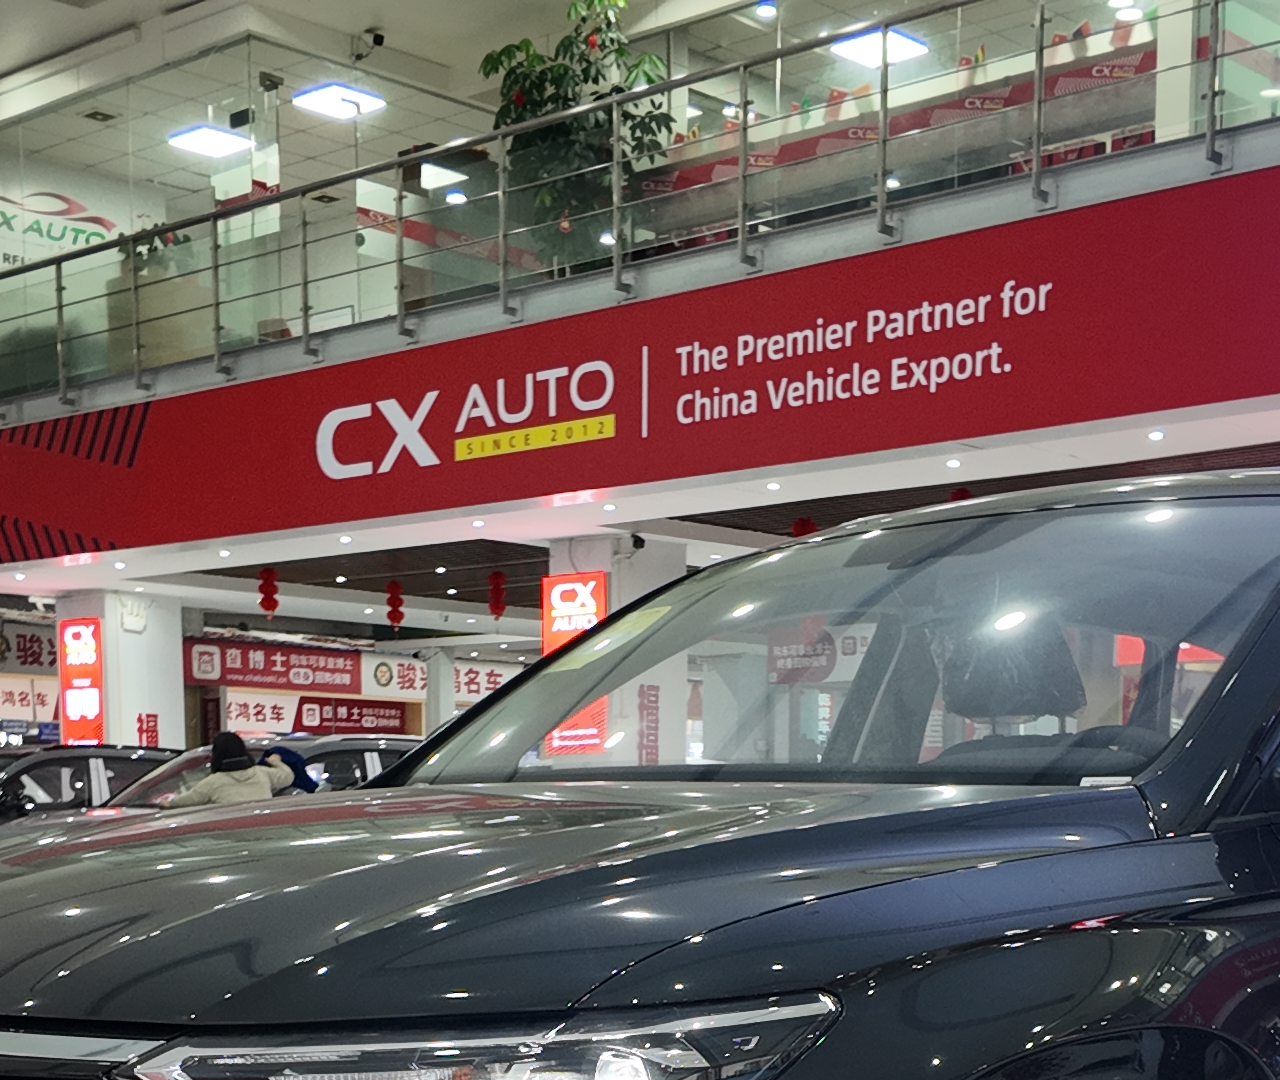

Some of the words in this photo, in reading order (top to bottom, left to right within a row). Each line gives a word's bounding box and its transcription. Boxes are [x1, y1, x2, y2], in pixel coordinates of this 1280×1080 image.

[676, 341, 729, 376] The
[736, 317, 858, 367] Premier
[866, 294, 992, 343] Partner
[1000, 280, 1053, 318] for
[676, 386, 758, 424] China
[766, 362, 880, 410] Vehicle
[890, 342, 1013, 394] Export.
[316, 390, 441, 480] CX
[454, 360, 615, 433] AUTO
[465, 432, 532, 456] SINCE
[550, 421, 607, 443] 2012
[550, 580, 597, 609] CX
[551, 614, 598, 632] AUTO
